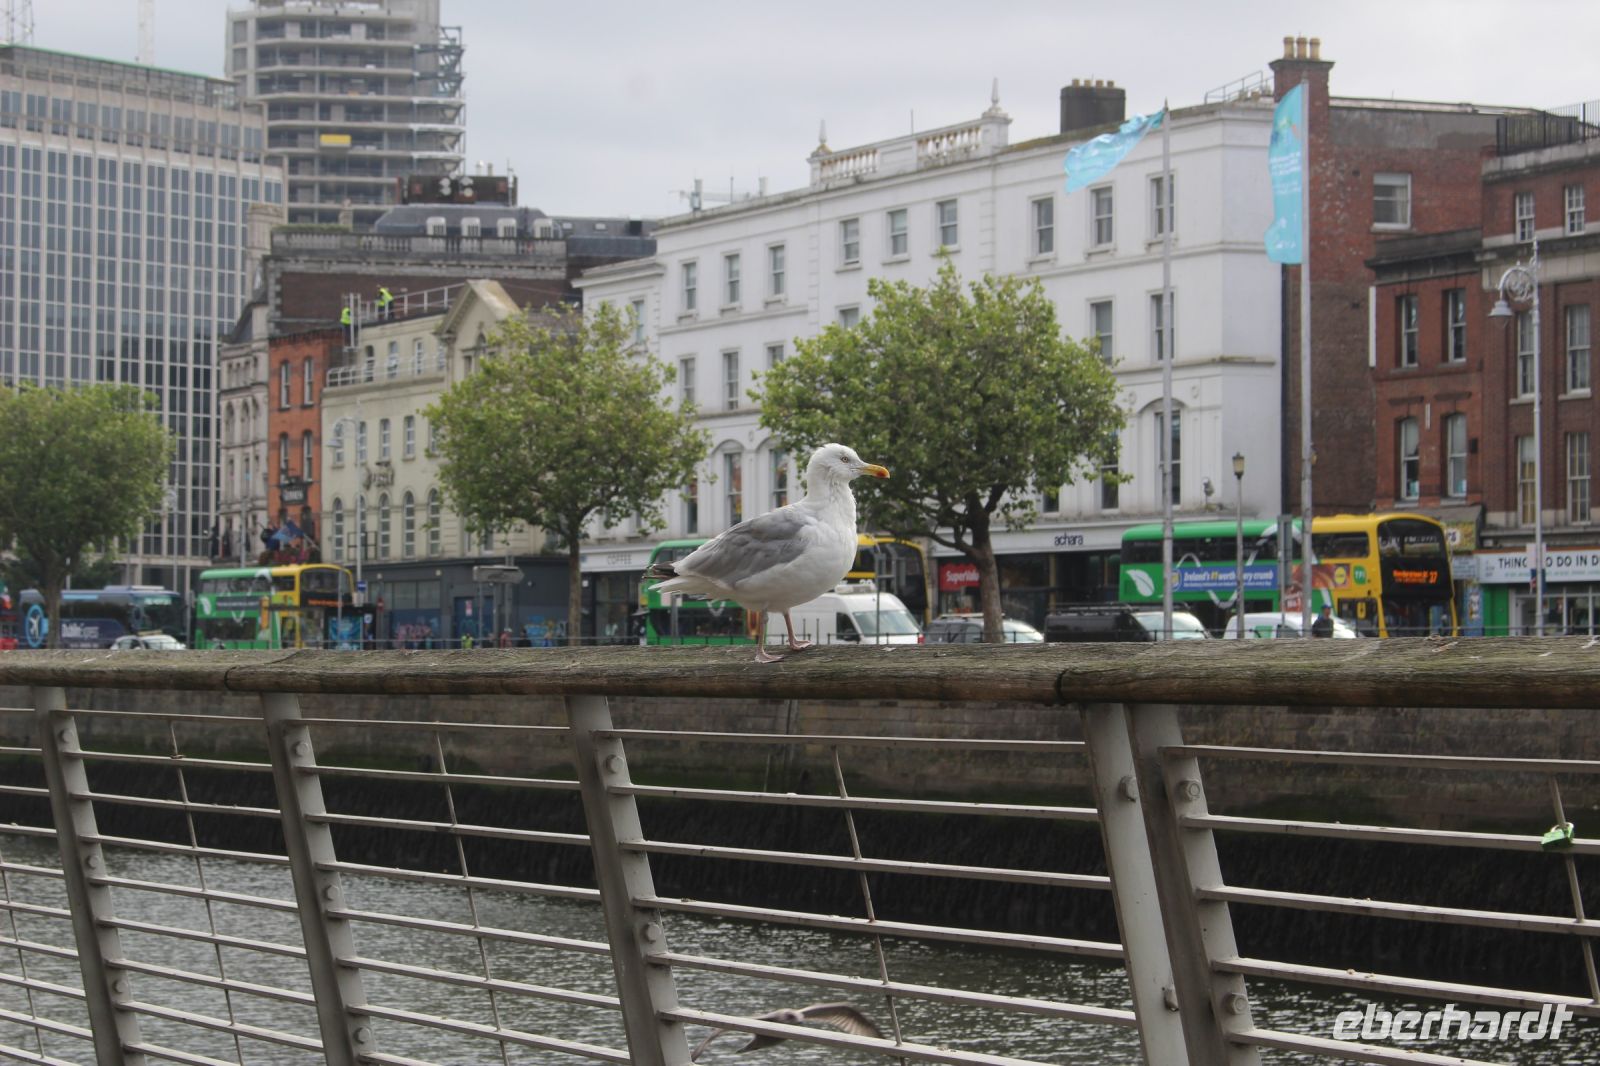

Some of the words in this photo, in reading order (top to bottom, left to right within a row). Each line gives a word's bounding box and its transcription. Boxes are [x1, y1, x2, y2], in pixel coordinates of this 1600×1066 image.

[1054, 531, 1084, 546] achara
[1556, 556, 1572, 567] DO
[1576, 555, 1588, 566] IN
